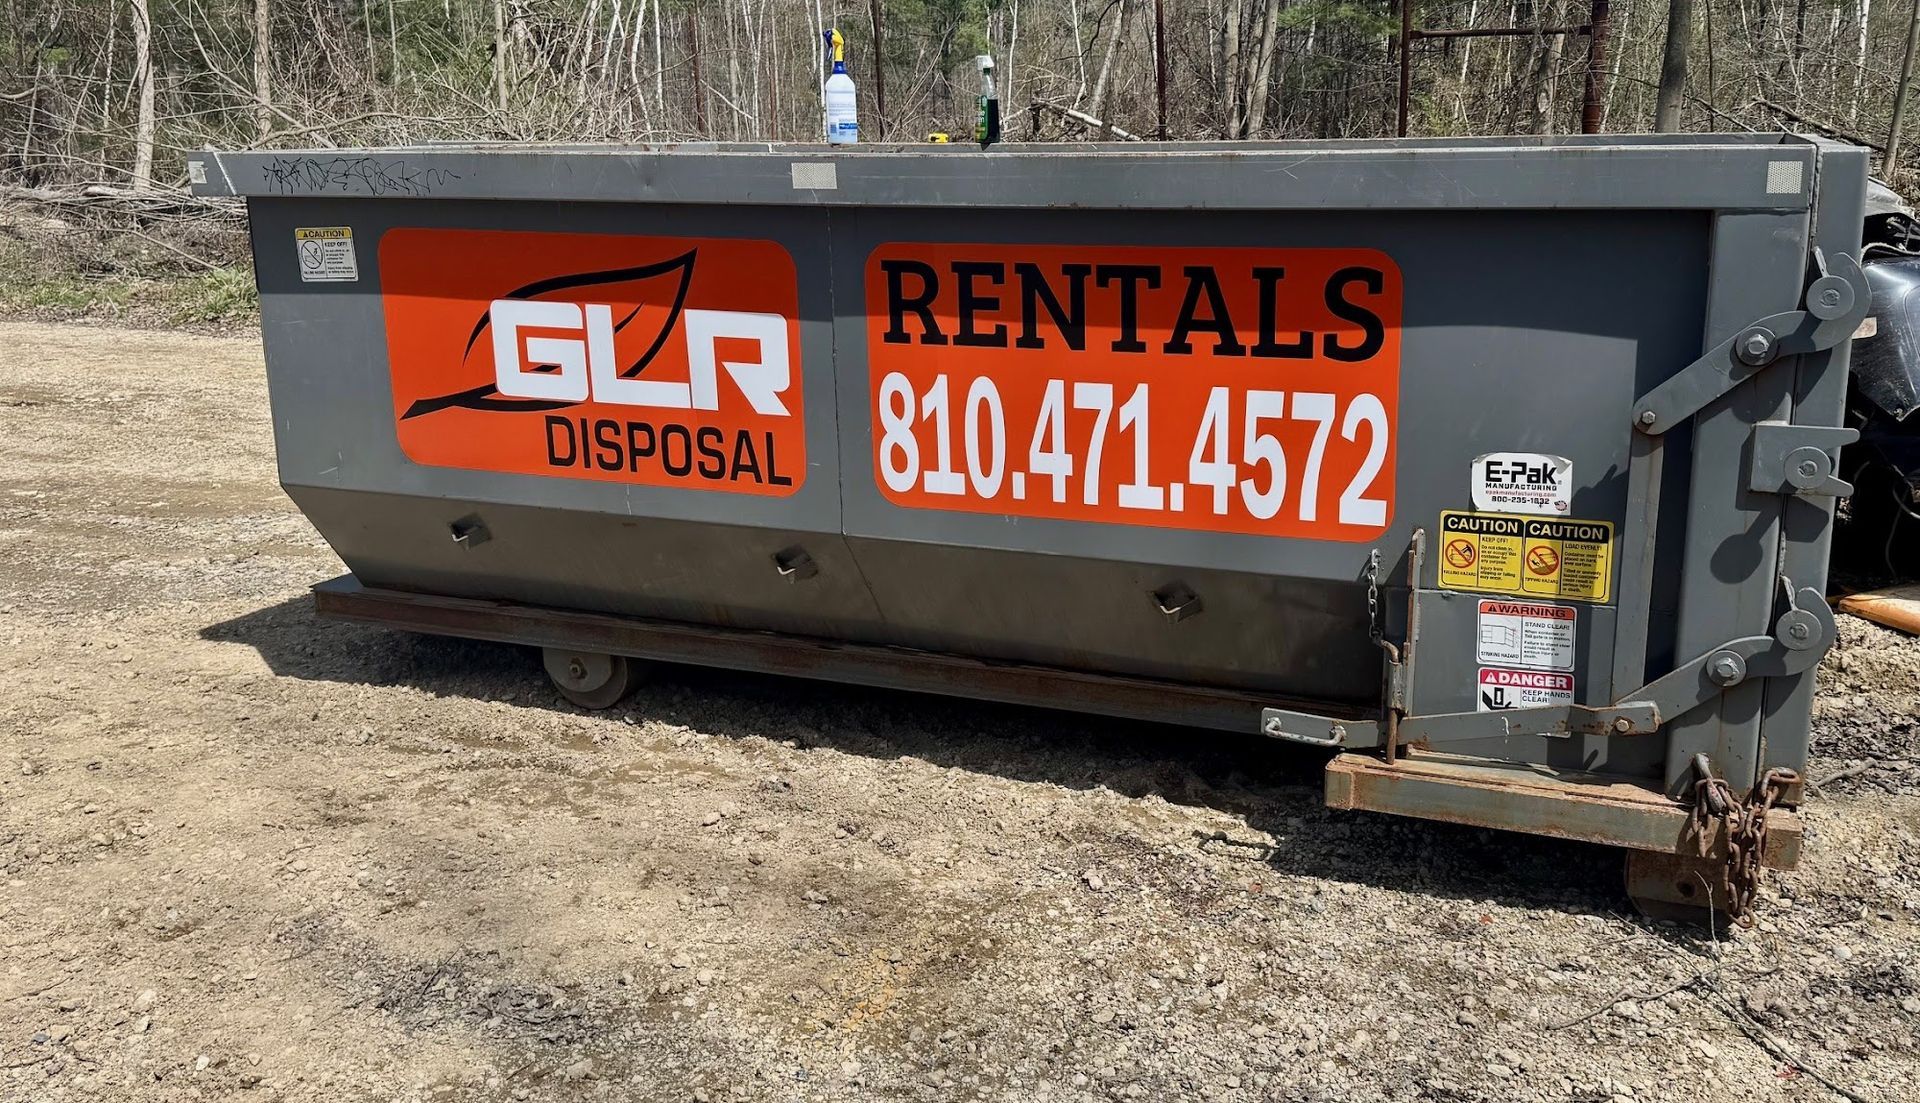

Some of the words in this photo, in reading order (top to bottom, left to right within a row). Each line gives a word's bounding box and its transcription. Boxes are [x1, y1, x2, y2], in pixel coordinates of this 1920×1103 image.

[881, 259, 1384, 362] RENTALS
[489, 299, 792, 417] GLR
[545, 415, 792, 487] DISPOSAL
[879, 372, 1389, 527] 810.471.4572
[1486, 461, 1557, 484] E-Pak
[1486, 482, 1557, 491] MANUFACTURING
[1447, 517, 1518, 533] CAUTION
[1529, 523, 1603, 540] CAUTION
[1498, 605, 1566, 617] WARNING
[1499, 673, 1567, 688] DANGER
